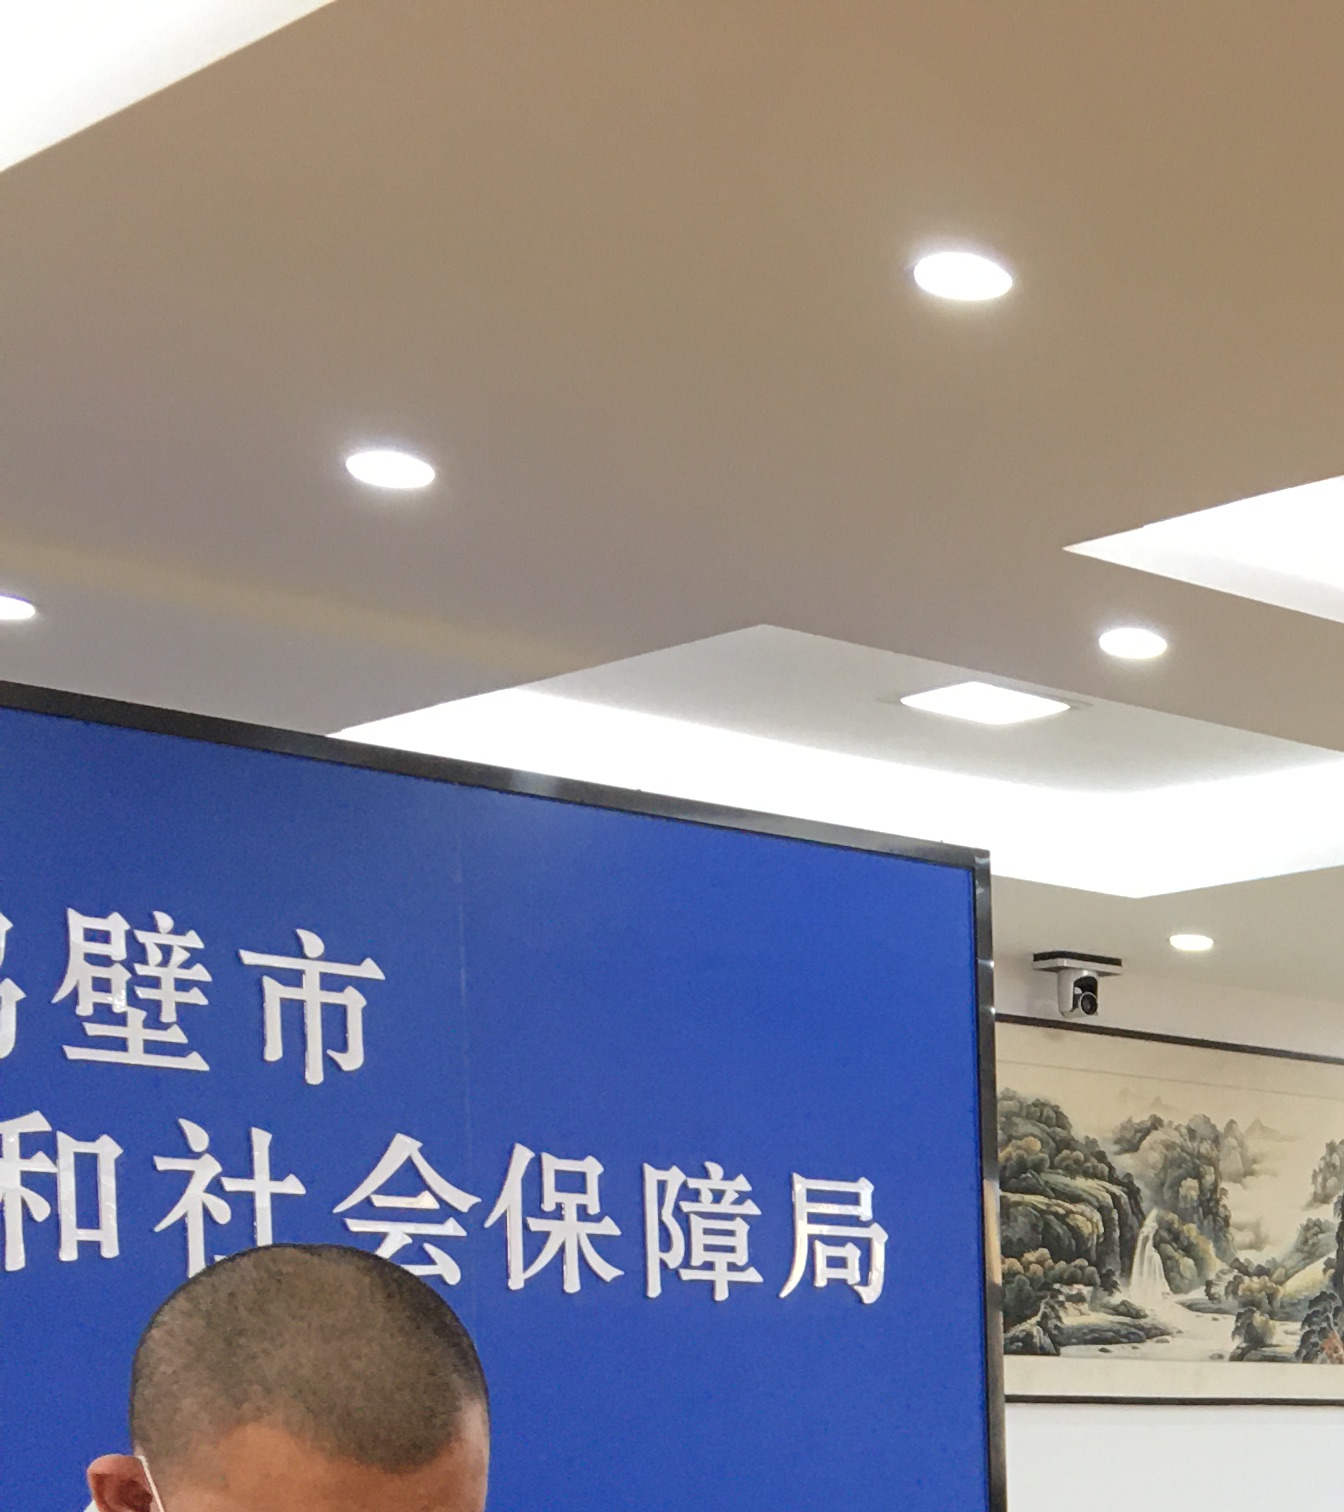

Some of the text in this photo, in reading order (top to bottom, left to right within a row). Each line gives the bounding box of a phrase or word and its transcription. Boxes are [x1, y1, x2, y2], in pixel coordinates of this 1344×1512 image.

[0, 1111, 890, 1306] 和社会保障局
